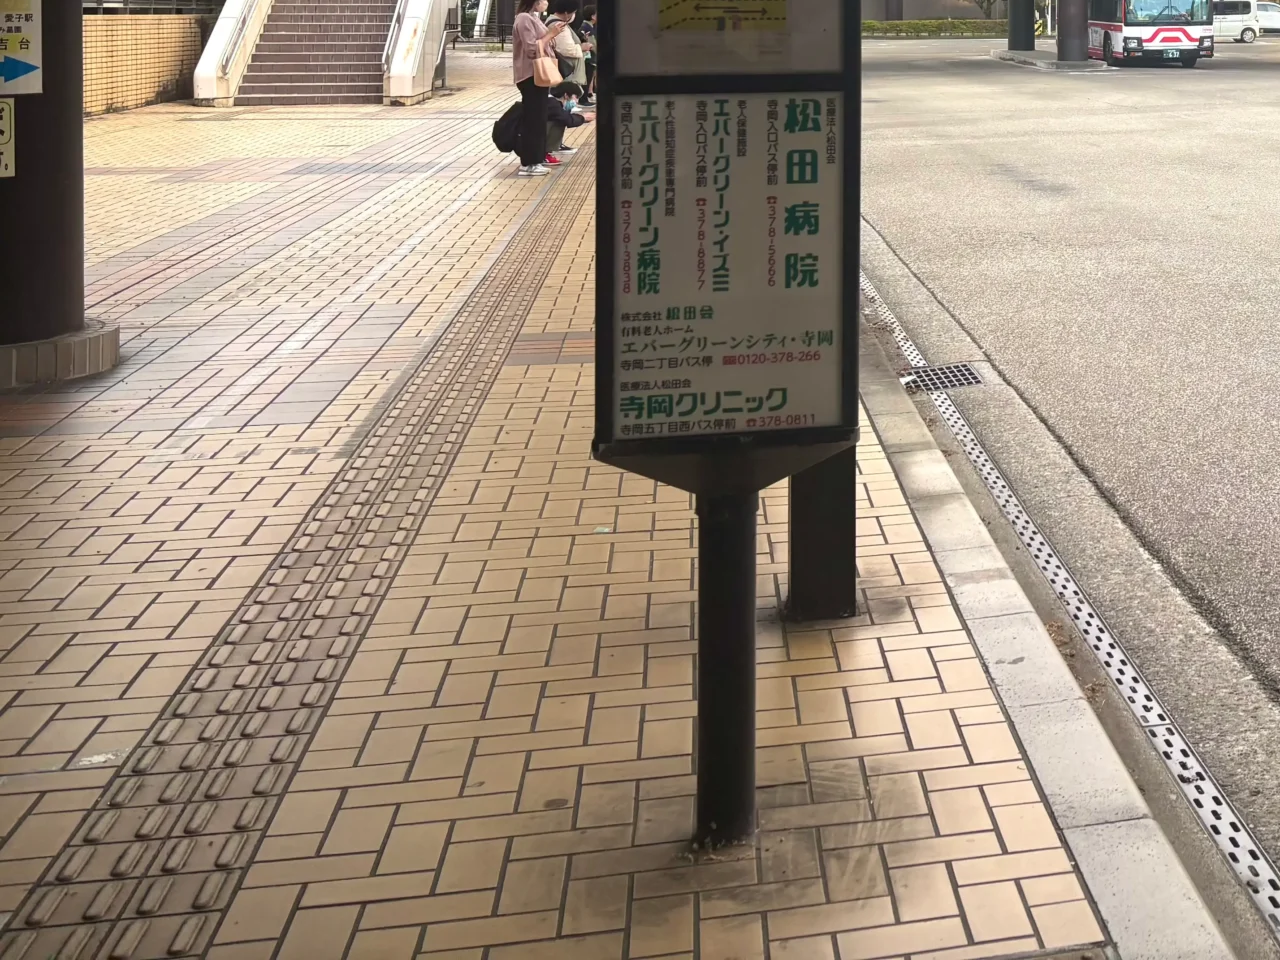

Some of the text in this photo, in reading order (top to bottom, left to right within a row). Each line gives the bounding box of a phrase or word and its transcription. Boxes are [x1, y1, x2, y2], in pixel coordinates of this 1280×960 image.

[4, 13, 34, 23] 愛子駅
[620, 101, 633, 190] 寺岡入口バス停前
[695, 100, 708, 188] 寺岡入口バス停前
[766, 99, 778, 186] 寺岡入口バス停前
[637, 100, 661, 295] エバーグリーン病院
[783, 98, 822, 289] 松田病院
[621, 311, 663, 322] 株式会社
[621, 325, 694, 338] 有料老人ホーム
[620, 351, 821, 371] 寺岡二丁目バス停 0120-378-266
[620, 387, 788, 419] 寺岡クリニック
[620, 413, 816, 435] 寺岡五丁目西バス停前 378-0811
